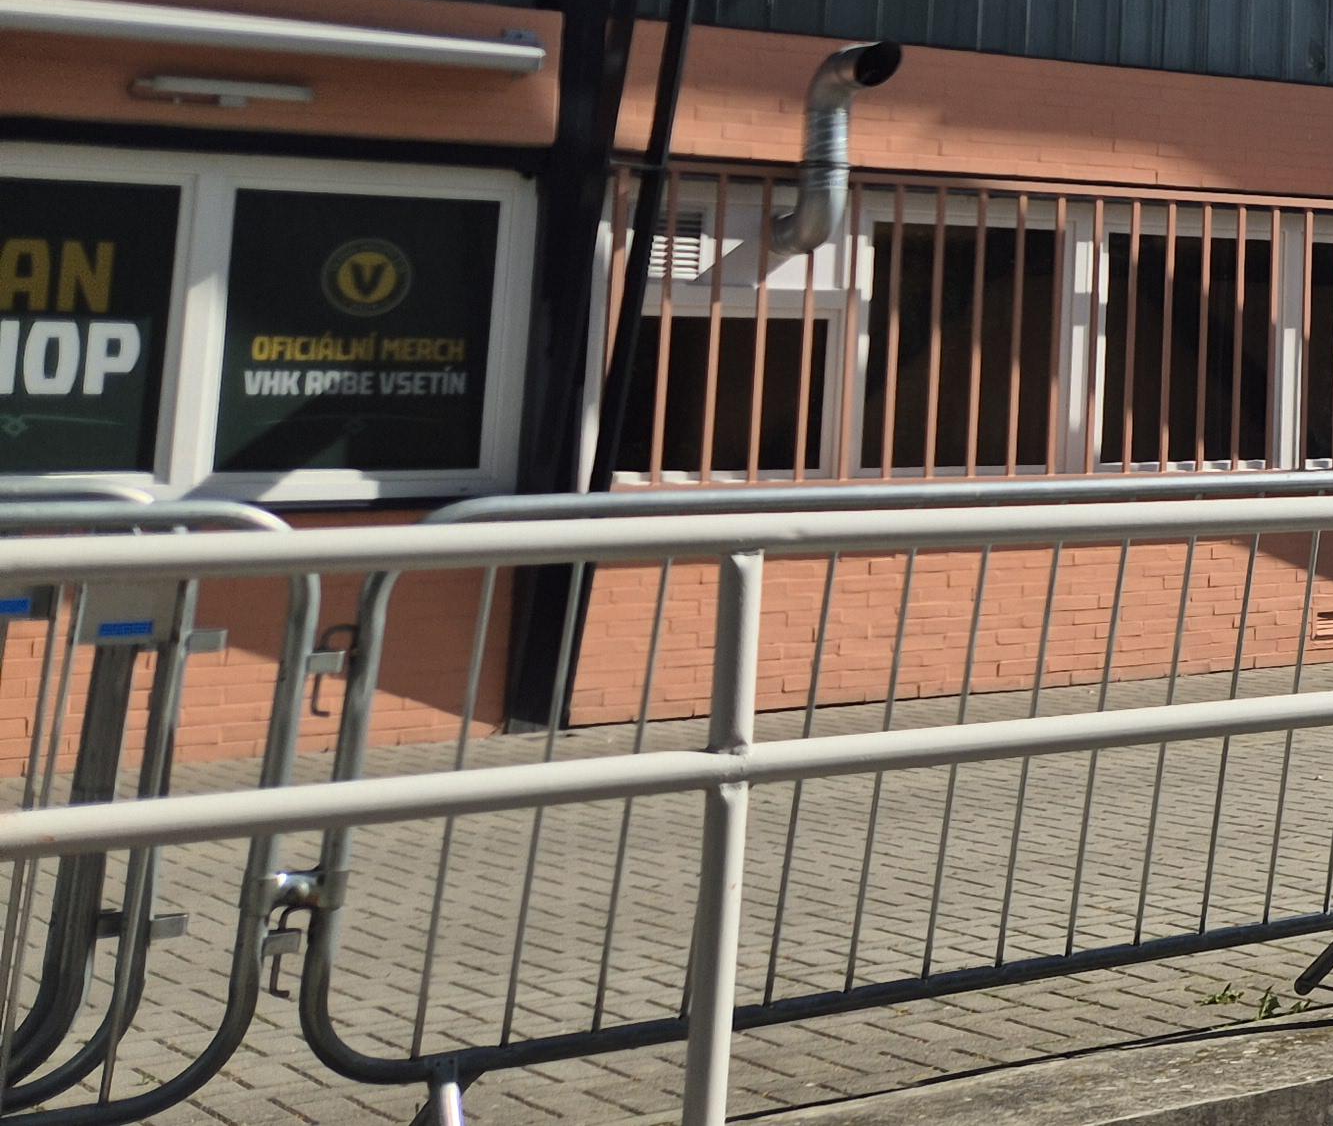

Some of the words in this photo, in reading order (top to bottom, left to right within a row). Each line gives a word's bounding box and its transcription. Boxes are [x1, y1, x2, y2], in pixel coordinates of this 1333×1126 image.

[251, 330, 377, 362] OFICIÁLNÍ
[381, 336, 465, 362] MERCH
[244, 370, 300, 396] VHK
[304, 370, 374, 396] ROBE
[380, 365, 467, 396] VSETÍN
